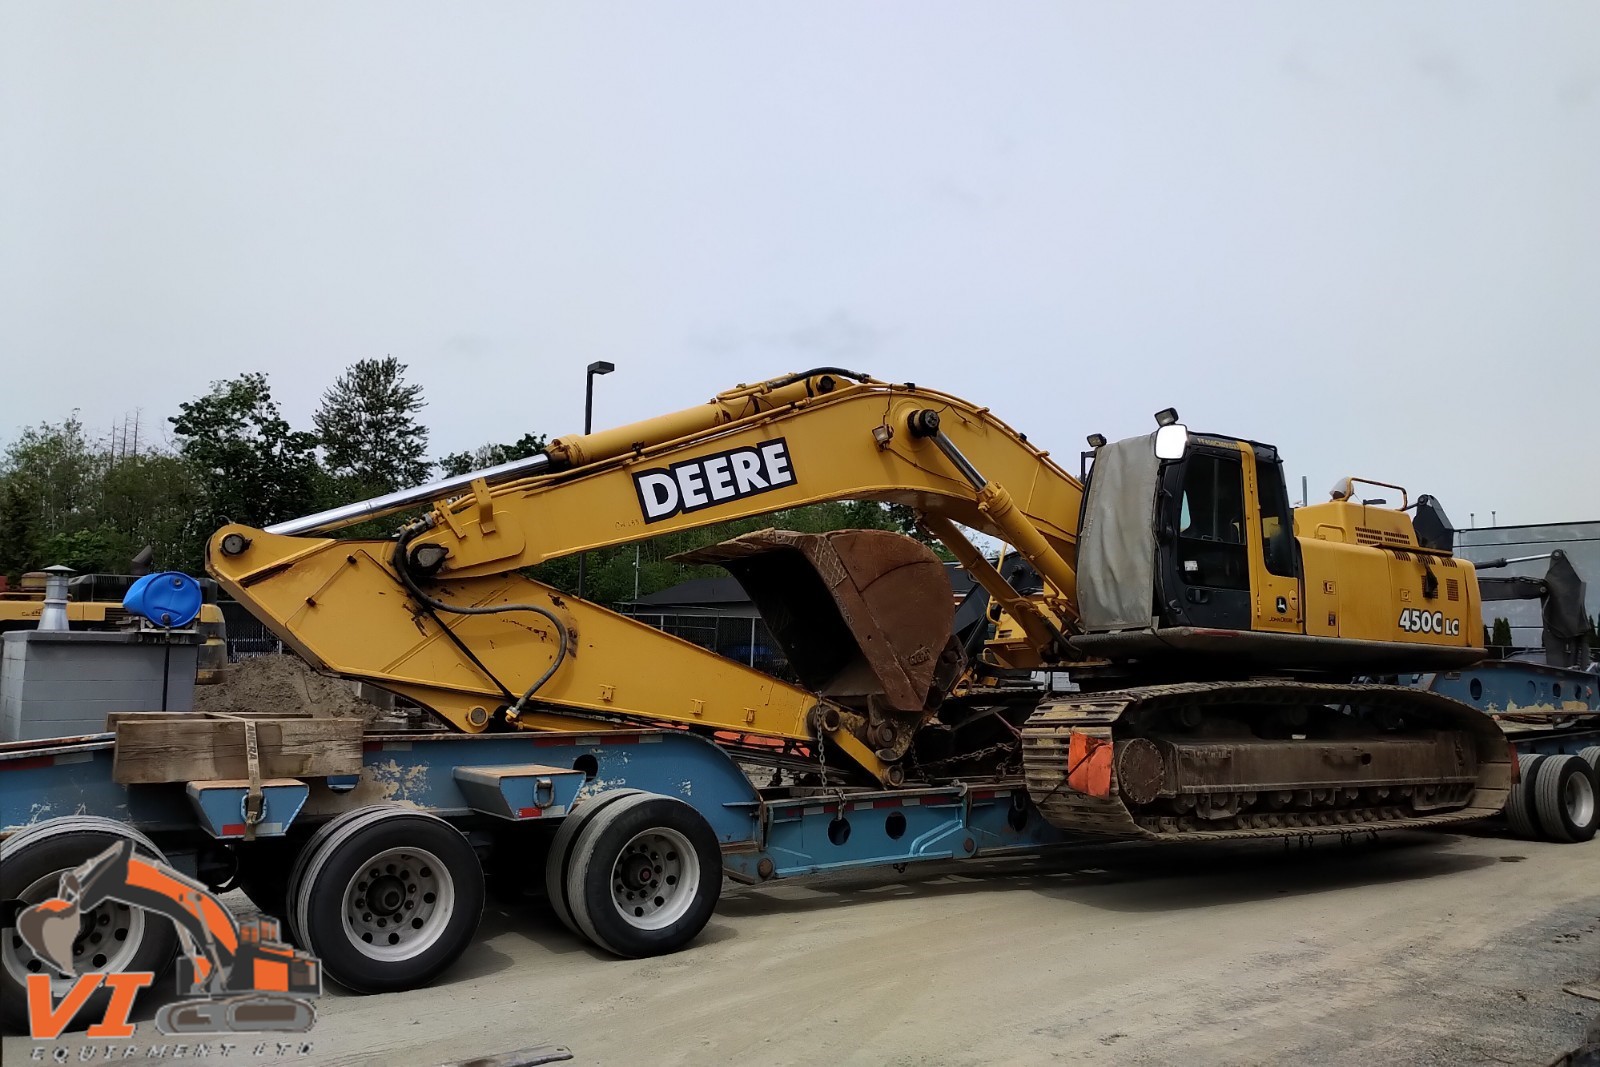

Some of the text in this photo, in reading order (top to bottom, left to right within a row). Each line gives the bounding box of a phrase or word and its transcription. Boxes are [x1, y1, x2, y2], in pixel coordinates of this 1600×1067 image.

[638, 442, 792, 518] DEERE
[1399, 609, 1459, 635] 450C LC
